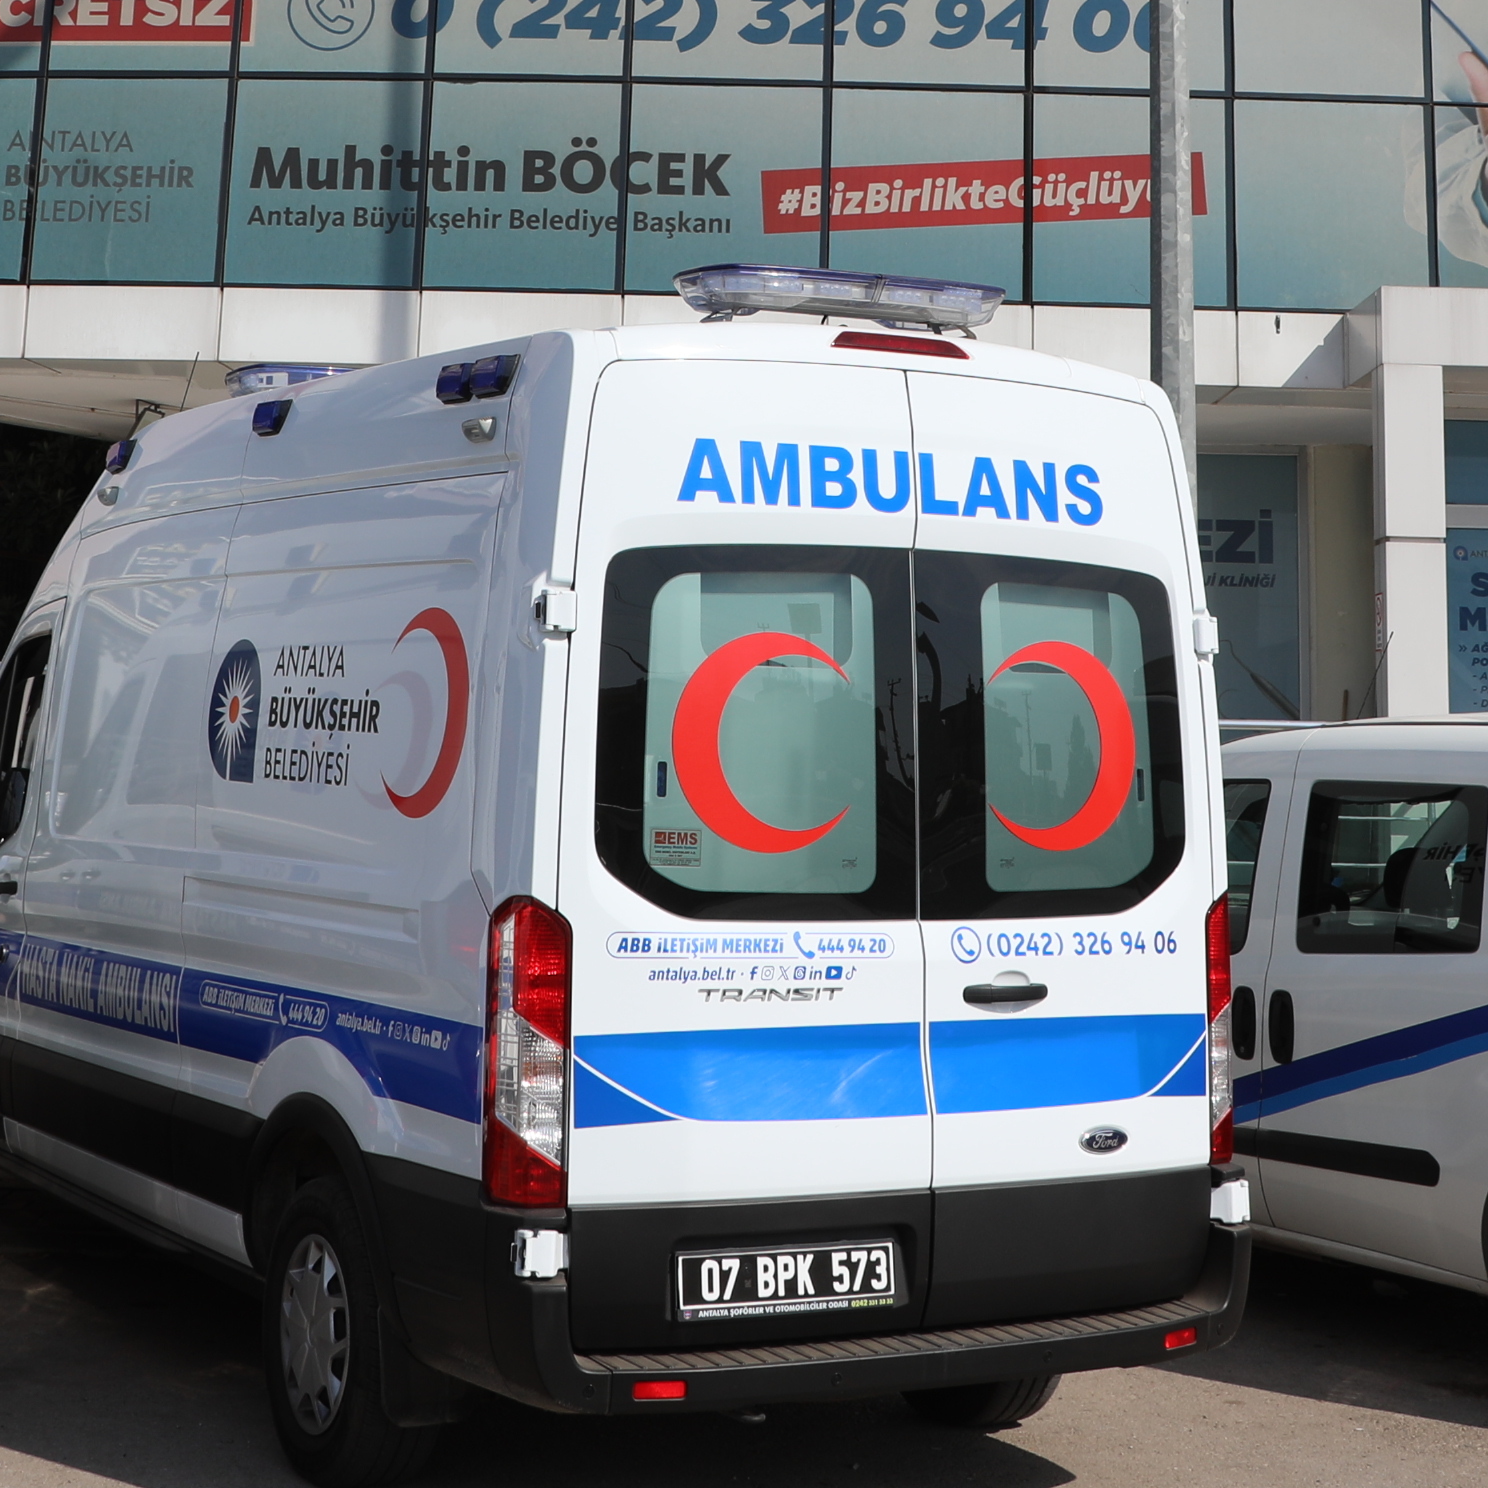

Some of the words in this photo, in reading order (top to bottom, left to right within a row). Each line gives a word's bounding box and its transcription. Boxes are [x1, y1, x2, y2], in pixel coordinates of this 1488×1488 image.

[6, 129, 135, 154] ANTALYA
[4, 158, 195, 194] BÜYÜKŞEHİR
[248, 144, 508, 193] Muhittin
[520, 137, 732, 198] BÖCEK
[2, 194, 152, 223] BELEDİYESİ
[778, 169, 1152, 218] #BizBirlikteGüçlüy
[246, 204, 346, 233] Antalya
[352, 206, 503, 236] Büyükşehir
[508, 208, 619, 238] Belediye
[632, 210, 731, 241] Başkanı
[677, 437, 1104, 527] AMBULANS
[1218, 573, 1276, 588] KLİNİĞİ
[273, 644, 347, 680] ANTALYA
[268, 687, 381, 740] BÜYÜKŞEHİR
[264, 743, 351, 788] BELEDİYESİ
[667, 832, 698, 845] EMS
[616, 937, 652, 954] ABB
[721, 938, 784, 954] MERKEZİ
[817, 938, 845, 953] 444
[848, 938, 865, 953] 94
[869, 938, 886, 953] 20
[986, 932, 1063, 957] (0242)
[1072, 932, 1112, 956] 326
[1120, 931, 1146, 955] 94
[1153, 930, 1177, 954] 06
[21, 943, 59, 1003] HASTA
[61, 952, 95, 1012] NAKİL
[97, 961, 177, 1033] AMBULANSI
[648, 966, 736, 984] antalya.bel.tr
[697, 987, 844, 1002] TRANSIT
[336, 1012, 382, 1035] antalya.bel.tr
[700, 1258, 741, 1302] 07
[756, 1253, 816, 1298] BPK
[831, 1249, 888, 1293] 573
[698, 1308, 729, 1318] ANTALYA
[730, 1306, 764, 1318] ŞOFÖRLER
[765, 1305, 774, 1314] VE
[775, 1301, 827, 1313] OTOMOBİLCİLER
[828, 1300, 849, 1309] ODASI
